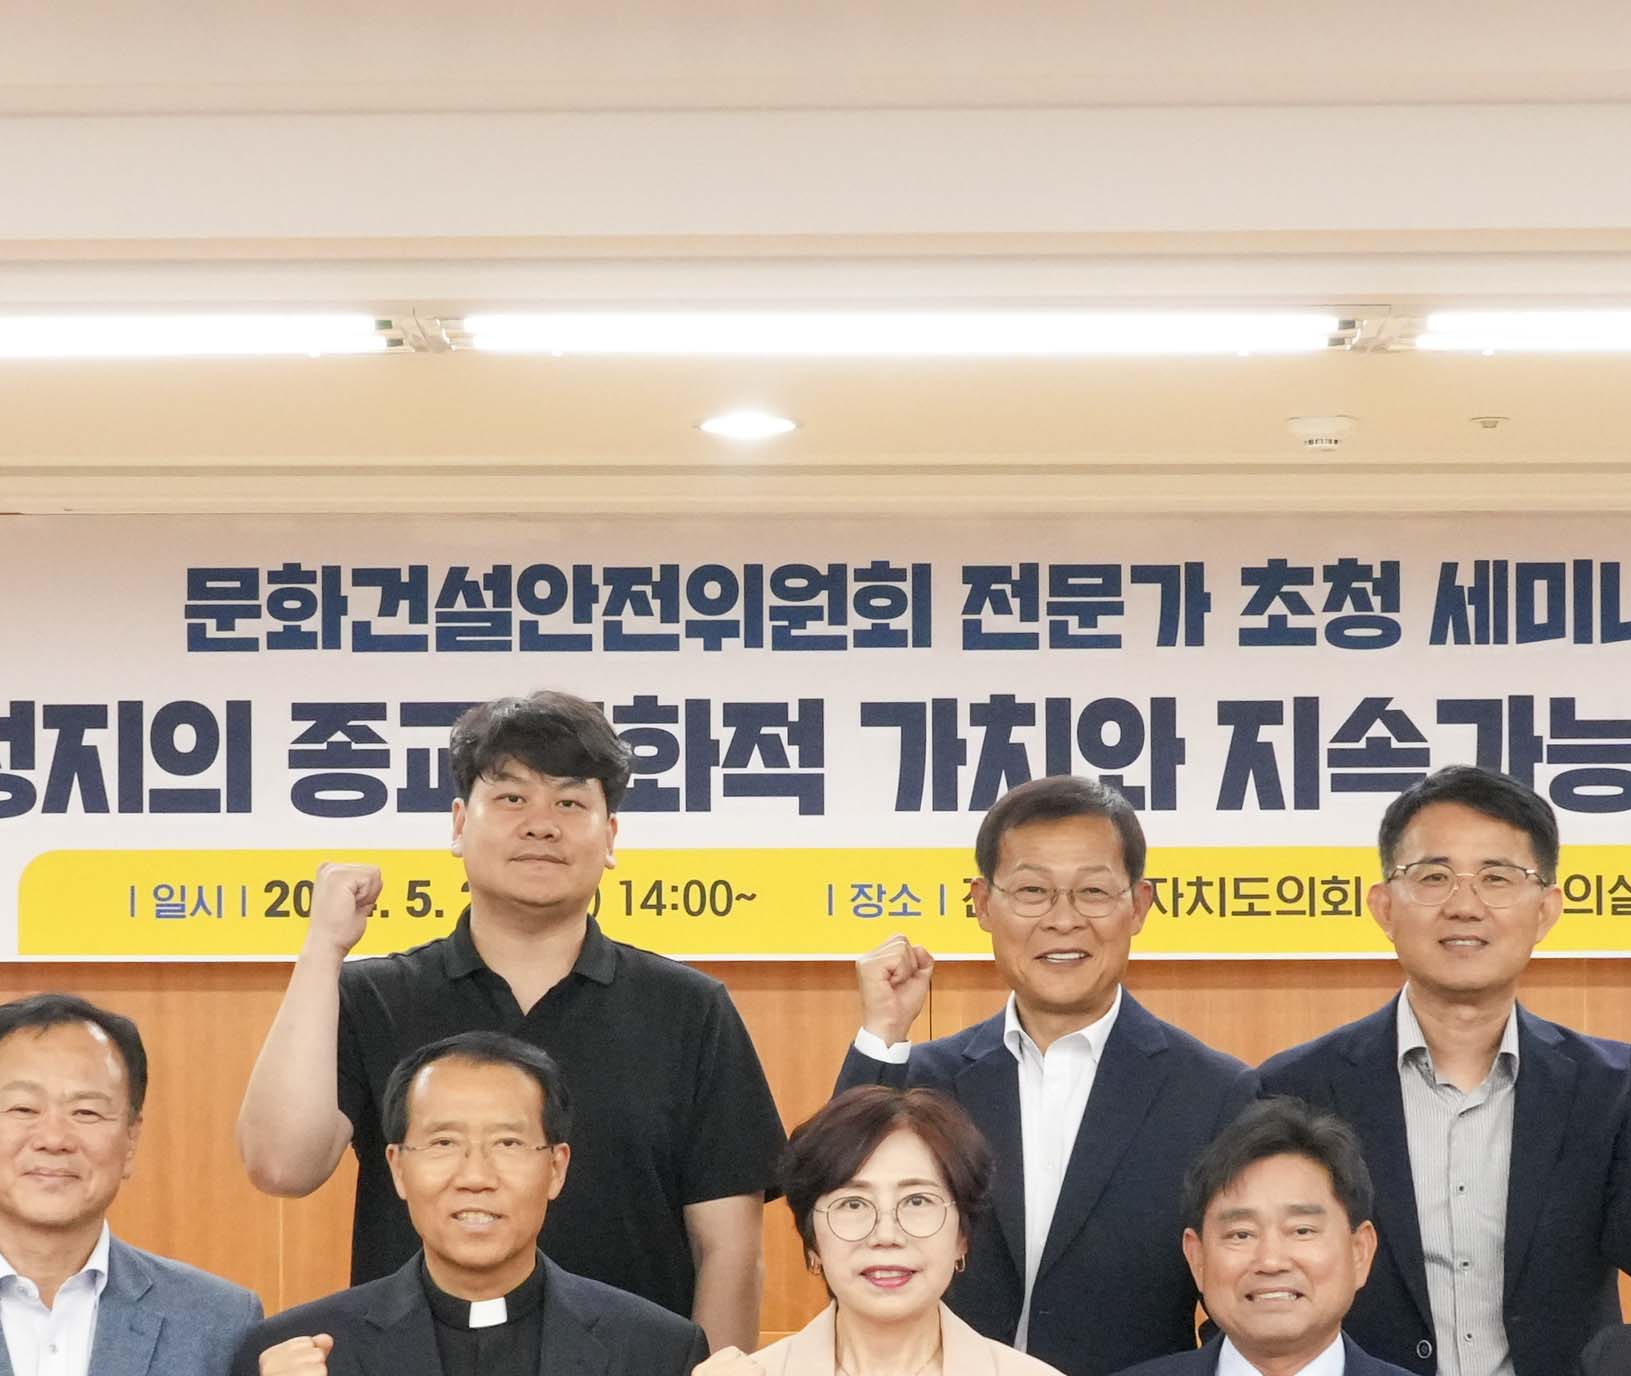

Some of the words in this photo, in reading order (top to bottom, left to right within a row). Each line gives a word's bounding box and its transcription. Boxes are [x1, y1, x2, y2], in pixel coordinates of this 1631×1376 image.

[183, 561, 932, 653] 문화건설안전위원회
[961, 560, 1212, 650] 전문가
[1237, 557, 1403, 651] 초청
[288, 695, 825, 818] 종교화적
[860, 694, 1186, 815] 가치와
[152, 882, 226, 919] 일시
[405, 878, 445, 919] 5.
[617, 877, 758, 918] 14:00~
[849, 882, 923, 918] 장소
